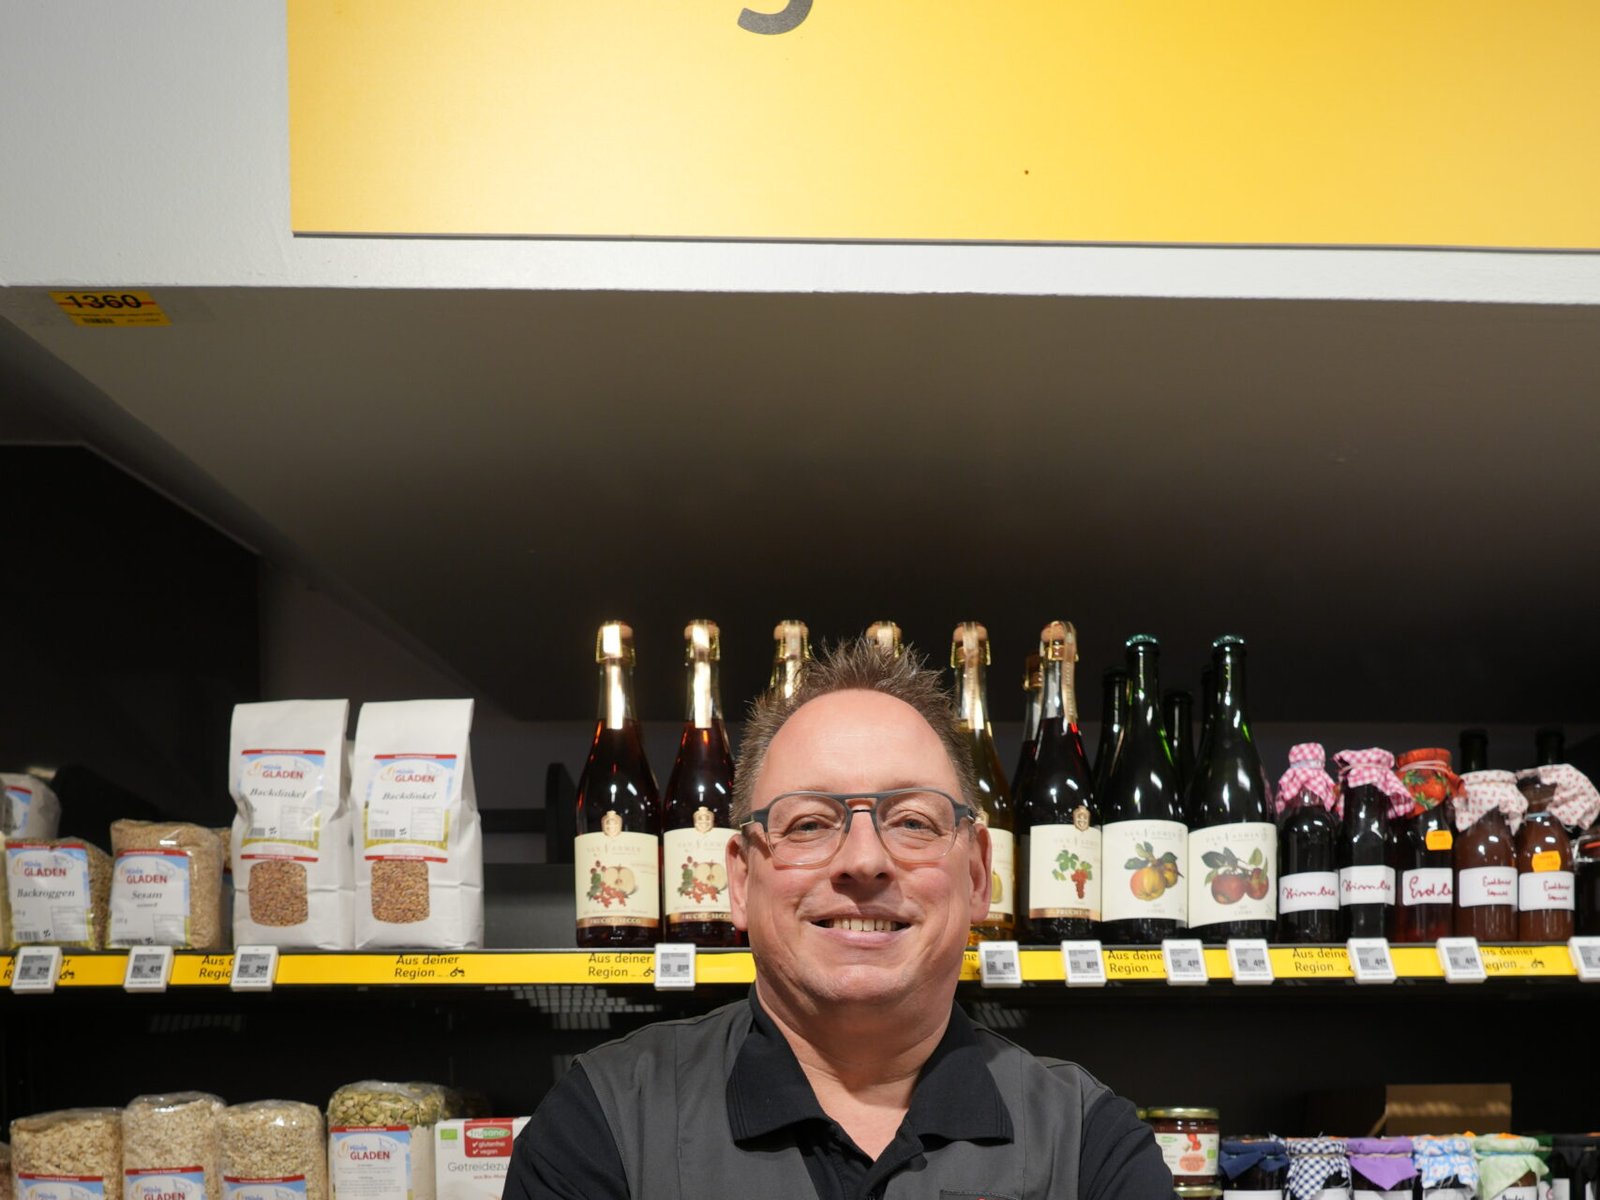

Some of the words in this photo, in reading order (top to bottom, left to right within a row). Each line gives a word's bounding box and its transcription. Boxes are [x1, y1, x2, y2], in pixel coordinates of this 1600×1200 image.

[65, 294, 142, 308] 1360
[262, 770, 303, 779] GLADEN
[395, 774, 435, 783] GLADEN
[382, 791, 437, 800] Backdinkel
[24, 868, 67, 878] GLADEN
[126, 875, 168, 884] GLADEN
[17, 887, 75, 900] Backroggen
[1107, 950, 1132, 961] Aus
[1134, 950, 1163, 961] deine
[1292, 948, 1315, 959] Aus
[1317, 948, 1347, 959] deine
[1498, 947, 1533, 957] deiner
[201, 955, 224, 966] Aus
[395, 955, 419, 965] Aus
[423, 954, 459, 965] deiner
[588, 953, 611, 964] Aus
[614, 953, 651, 964] deiner
[1110, 963, 1149, 975] Region
[1295, 961, 1334, 974] Region
[1485, 959, 1517, 971] egion
[199, 968, 231, 980] Regio
[394, 968, 435, 980] Region
[588, 966, 628, 979] Region
[350, 1151, 390, 1161] GLADEN
